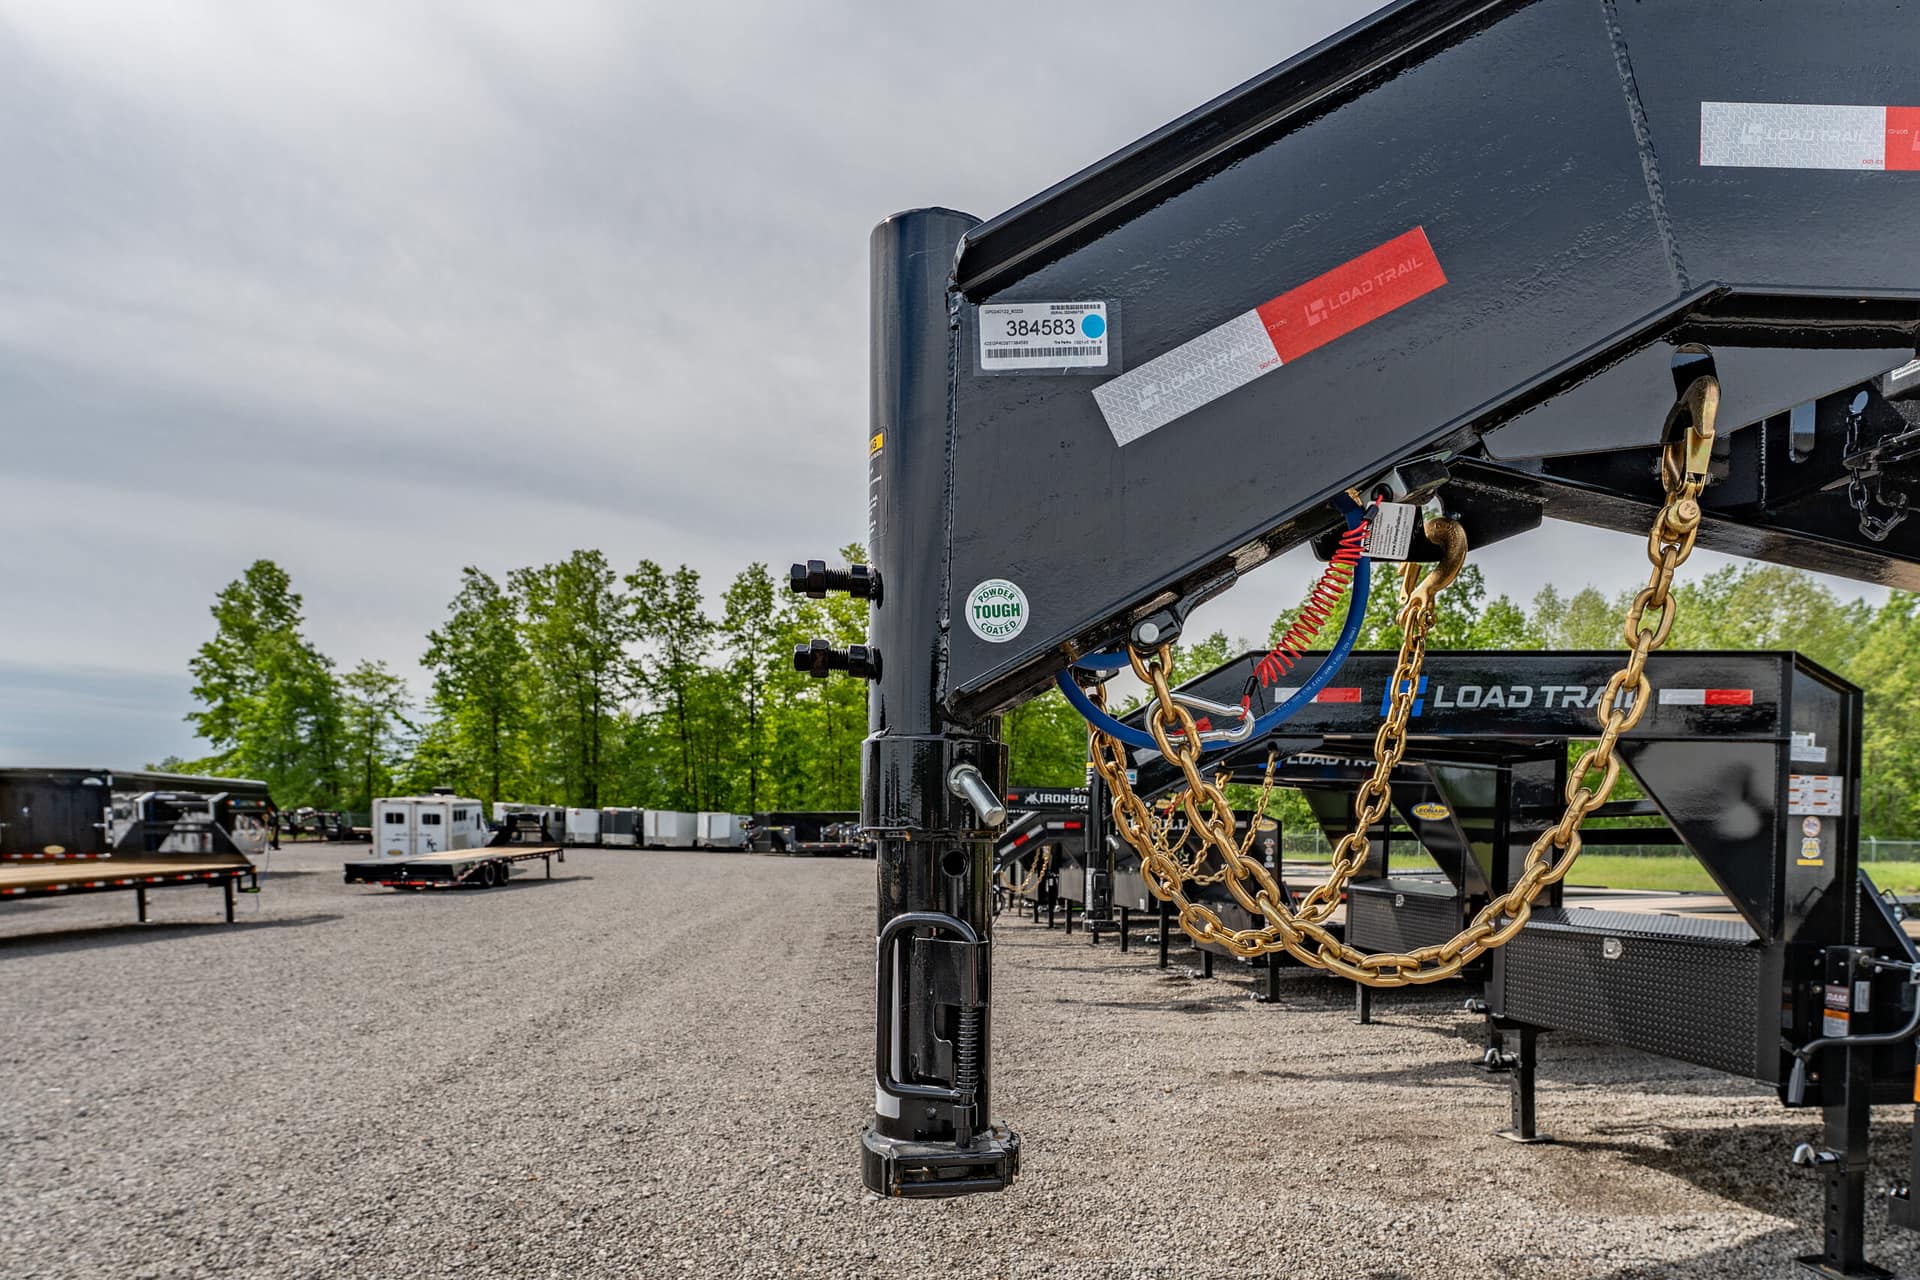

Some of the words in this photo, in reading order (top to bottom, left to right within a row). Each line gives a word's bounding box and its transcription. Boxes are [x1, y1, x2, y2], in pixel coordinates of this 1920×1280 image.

[1329, 278, 1374, 311] LOAD
[1377, 257, 1424, 288] TRAIL
[1006, 318, 1076, 337] 384583
[977, 587, 1016, 603] POWDER
[973, 602, 1021, 619] TOUGH
[980, 620, 1017, 635] COATED
[1433, 685, 1534, 709] LOAD
